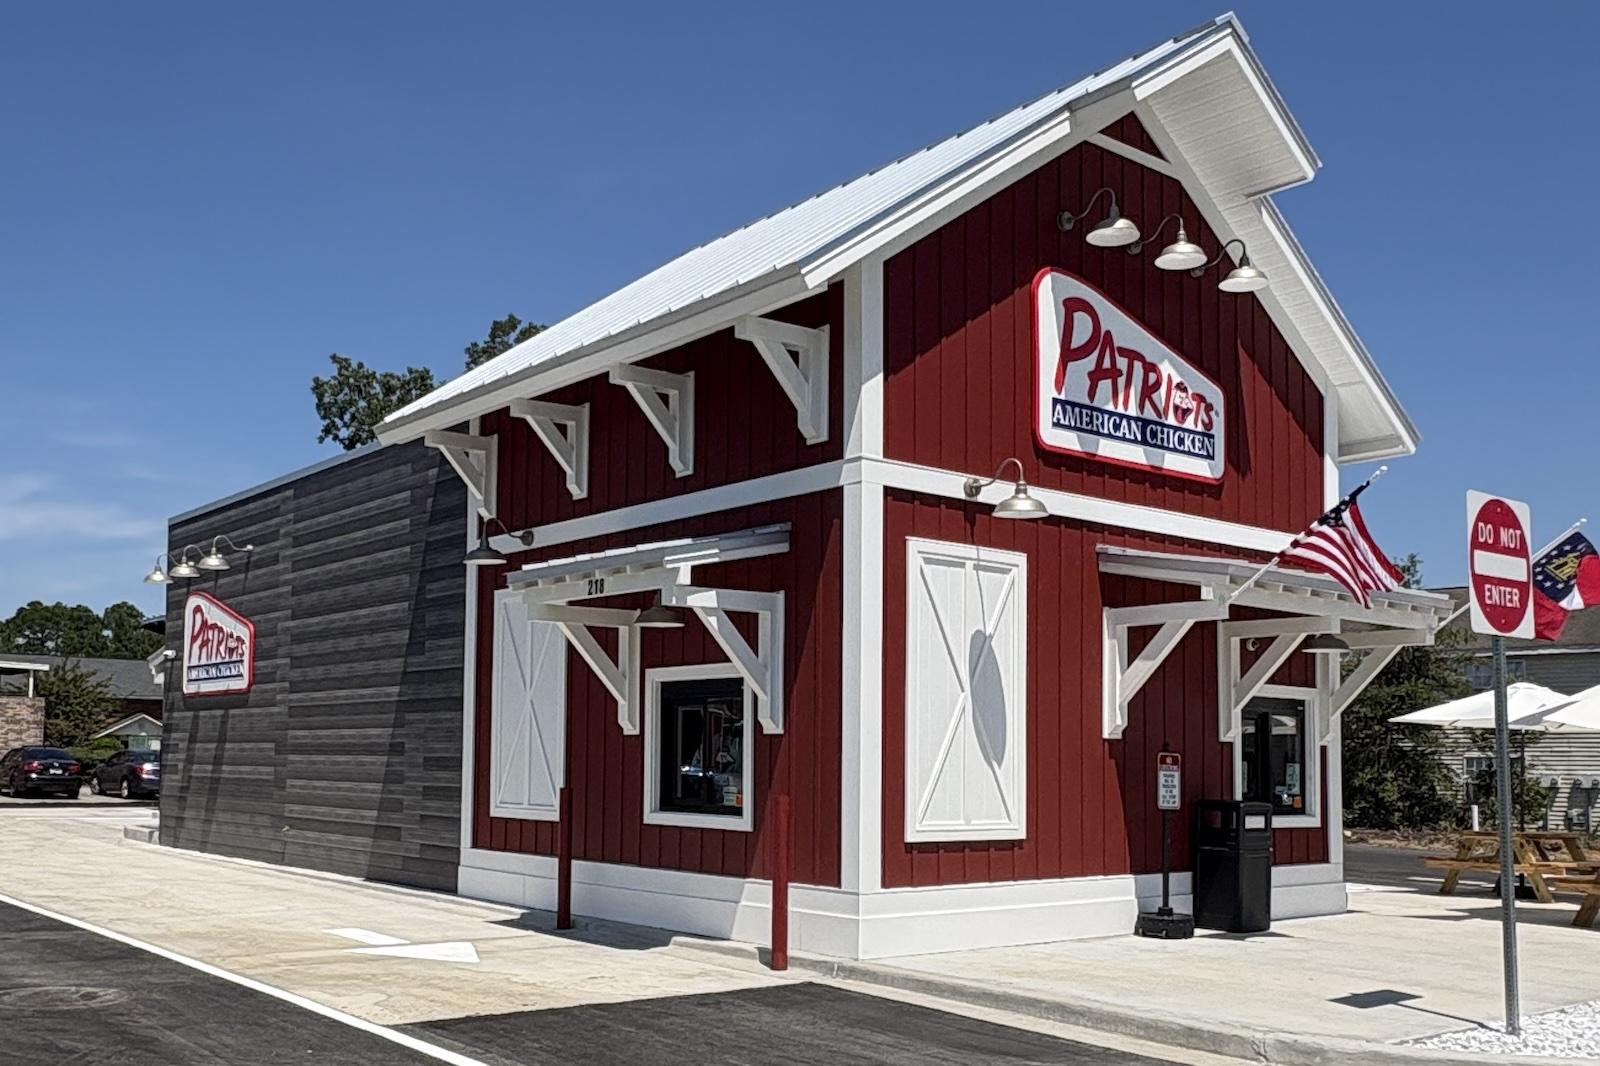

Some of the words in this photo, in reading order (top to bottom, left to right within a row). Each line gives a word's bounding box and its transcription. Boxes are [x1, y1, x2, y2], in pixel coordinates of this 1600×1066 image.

[1053, 402, 1142, 442] AMERICAN
[1146, 424, 1214, 457] CHICKEN
[1478, 522, 1494, 544] DO
[1500, 527, 1522, 549] NOT
[588, 578, 604, 595] 218
[1484, 584, 1520, 608] ENTER
